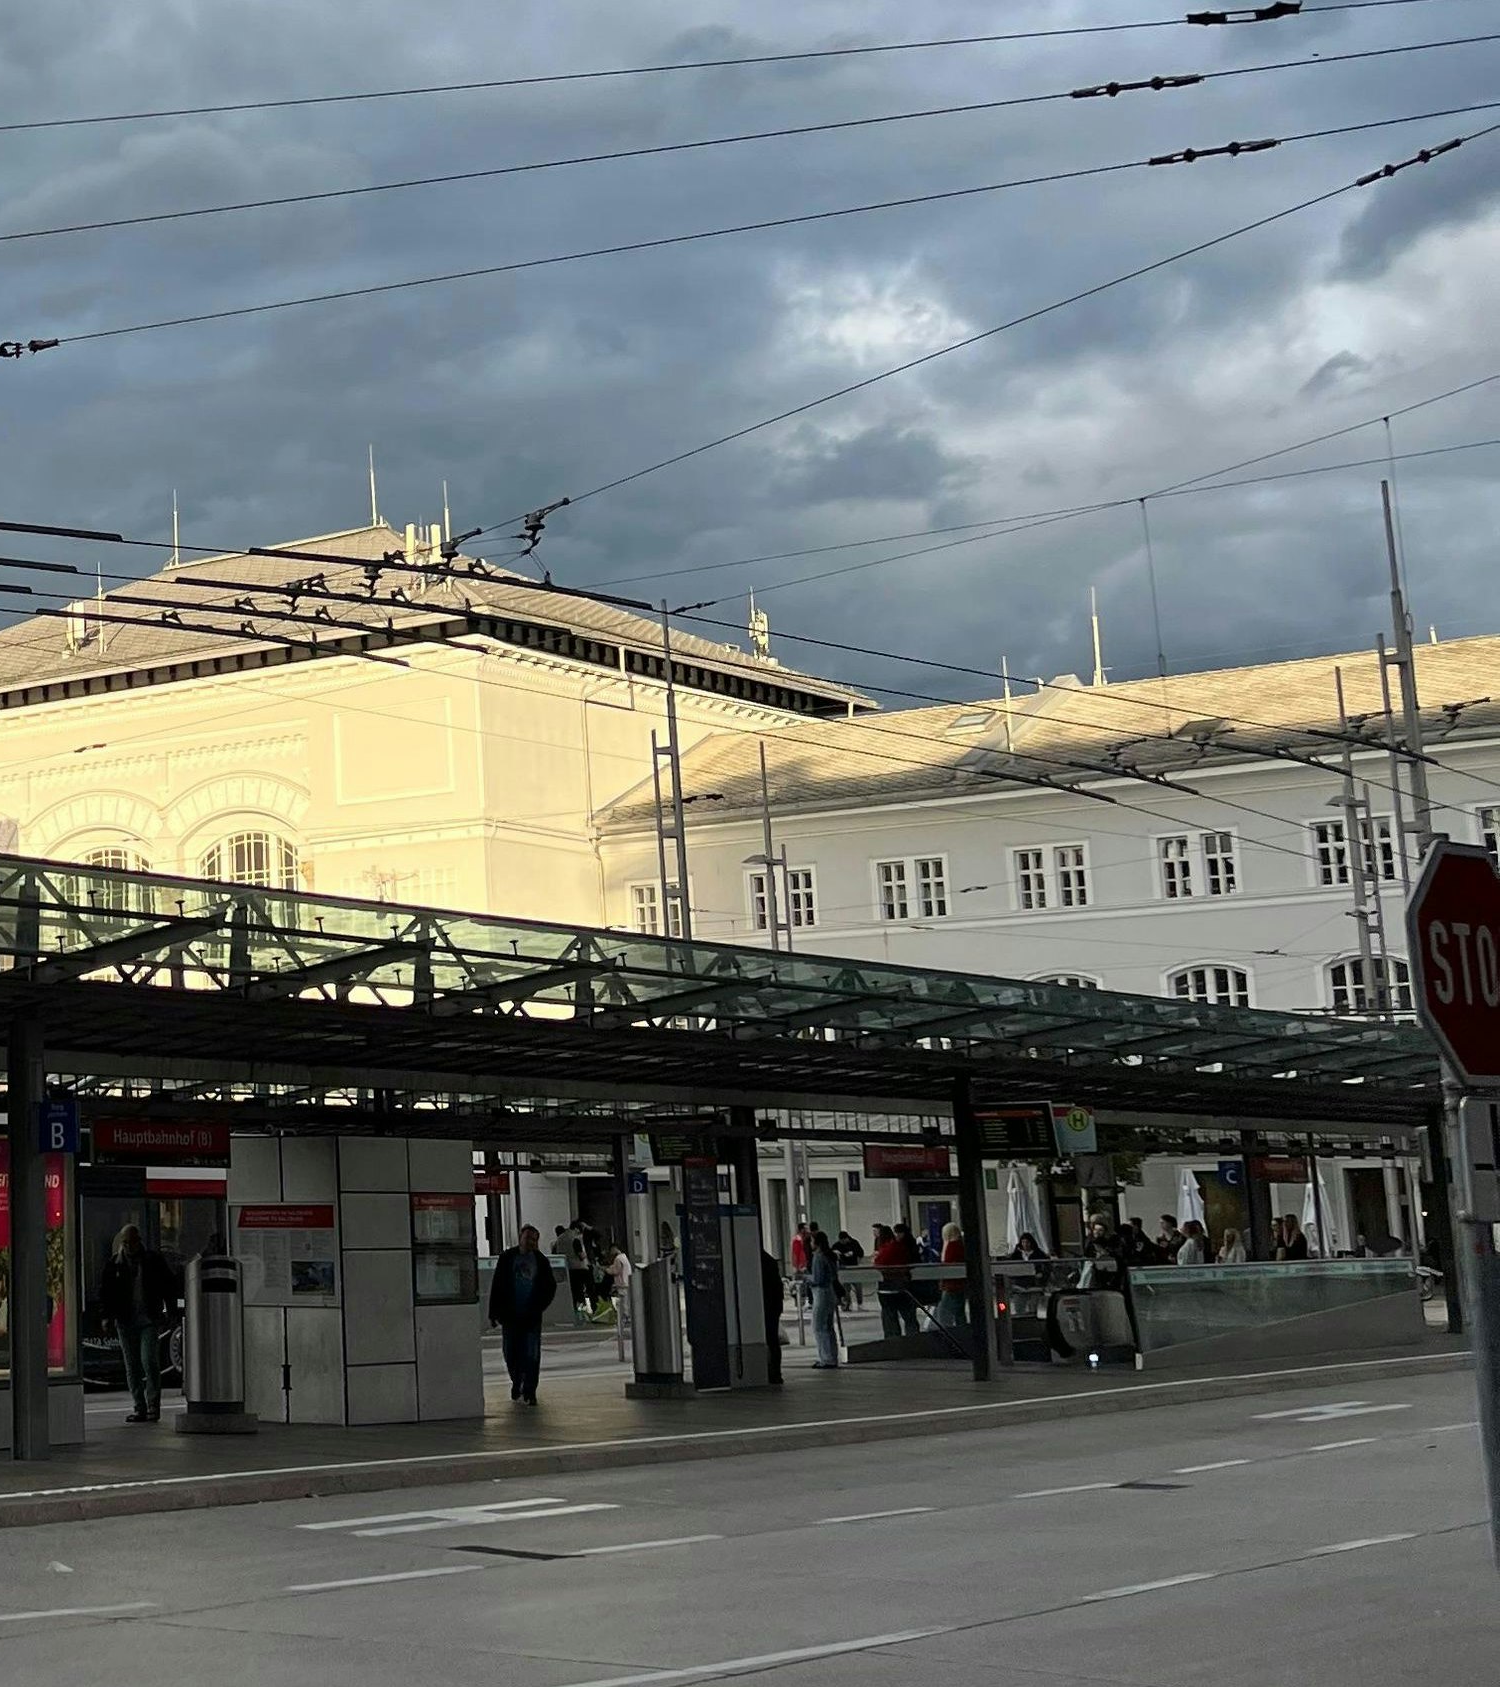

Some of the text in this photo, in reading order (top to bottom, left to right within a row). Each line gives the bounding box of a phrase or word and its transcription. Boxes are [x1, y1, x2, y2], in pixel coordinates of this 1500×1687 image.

[1428, 919, 1500, 1008] STO
[50, 1122, 65, 1149] B
[112, 1127, 213, 1149] Hauptbahnhof (B)
[633, 1180, 643, 1193] D
[1225, 1168, 1238, 1185] C
